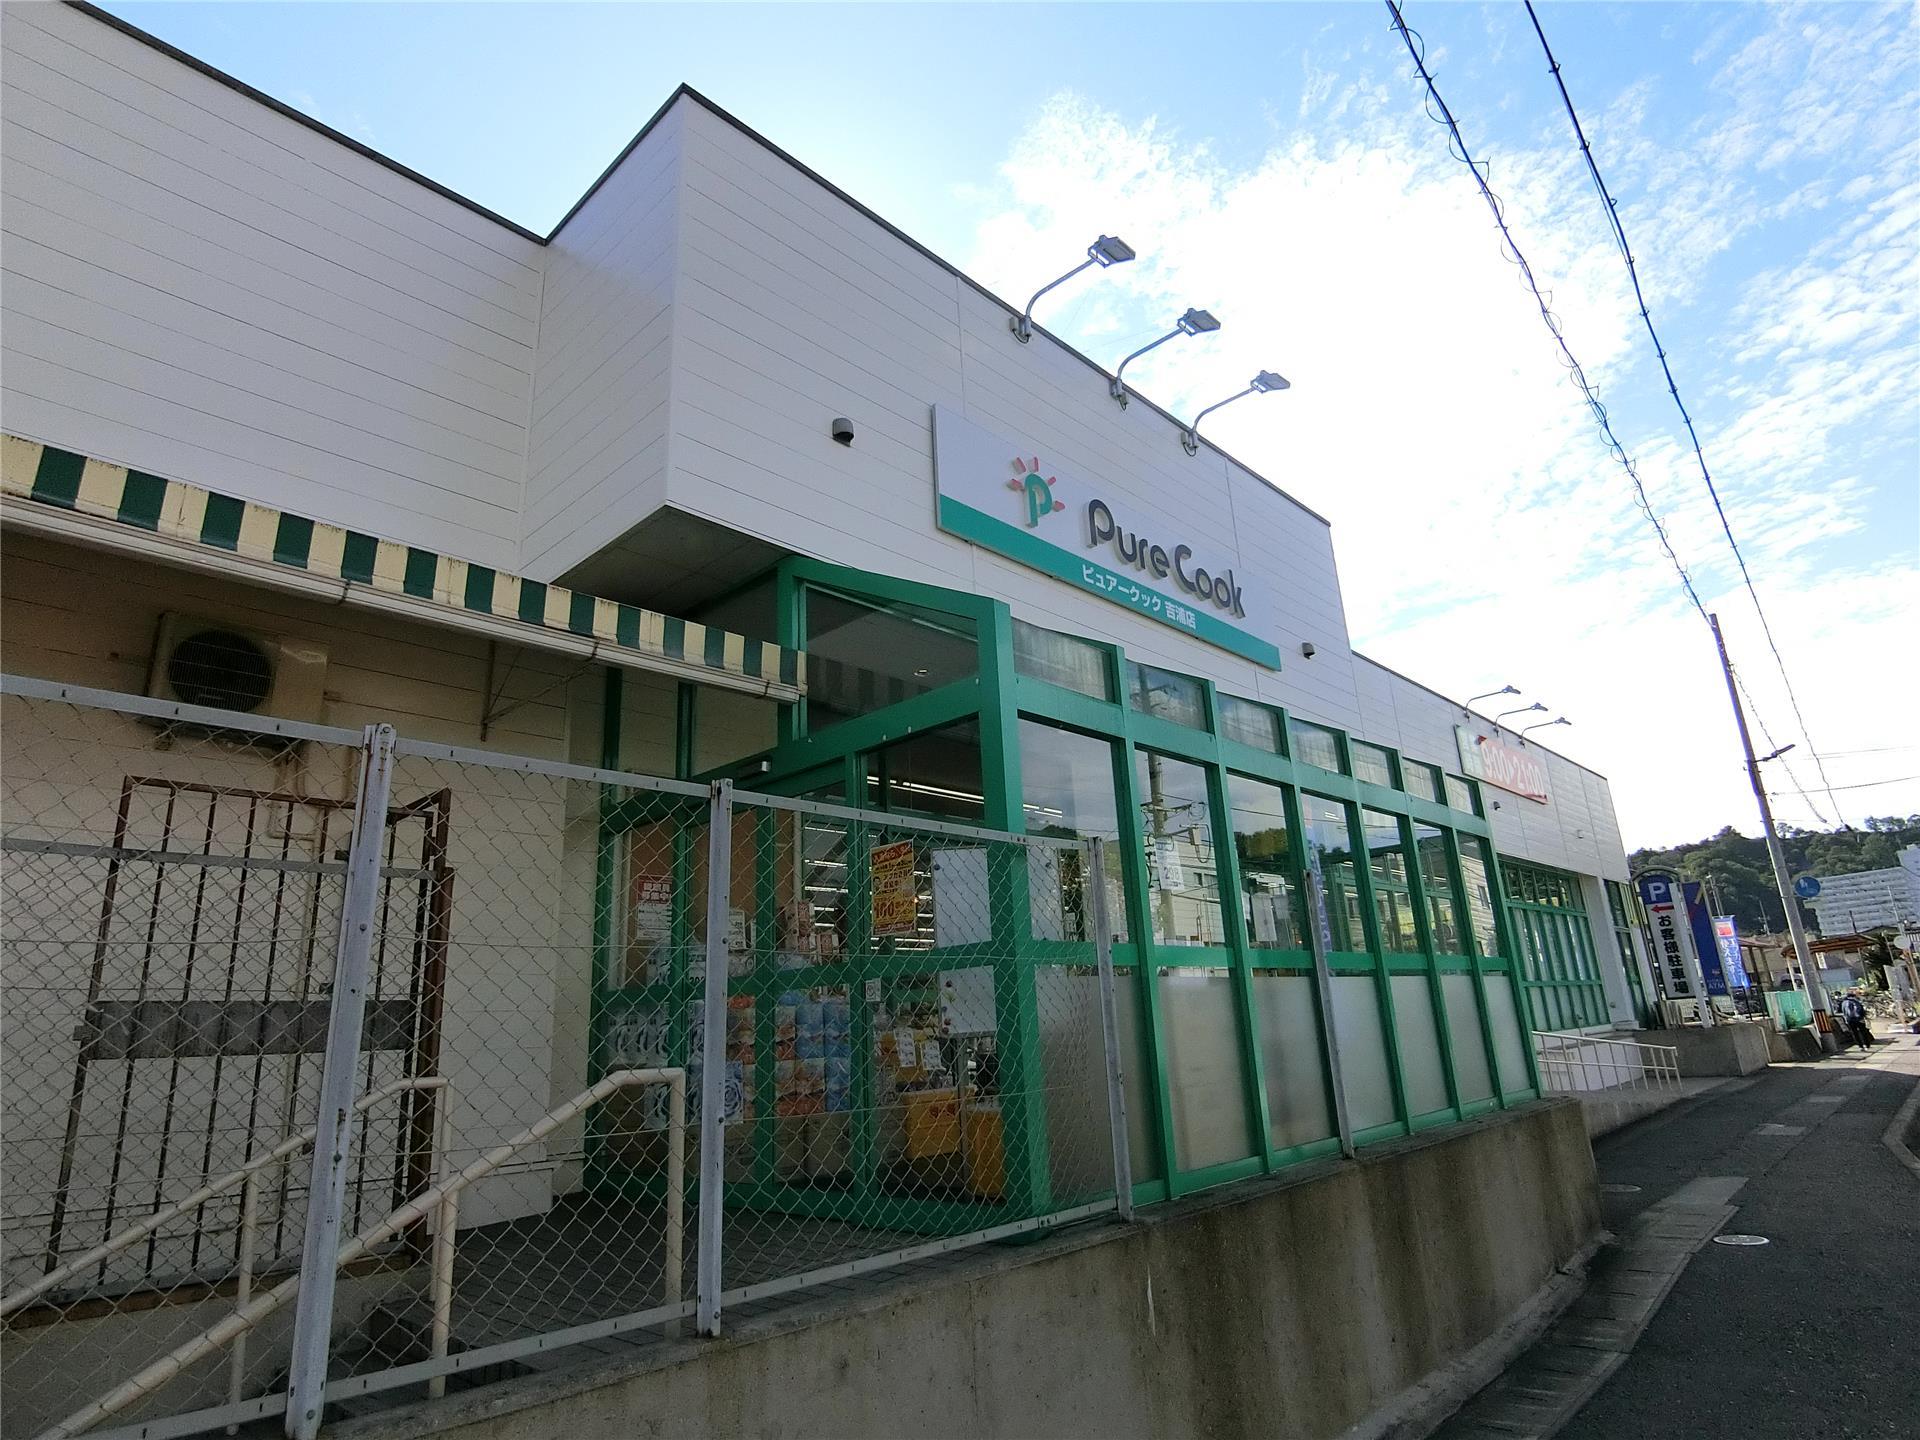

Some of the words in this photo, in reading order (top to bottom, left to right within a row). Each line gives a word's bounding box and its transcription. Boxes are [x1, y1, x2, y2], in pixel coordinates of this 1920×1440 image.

[1648, 882, 1666, 901] P
[1658, 915, 1689, 994] お客様駐車場
